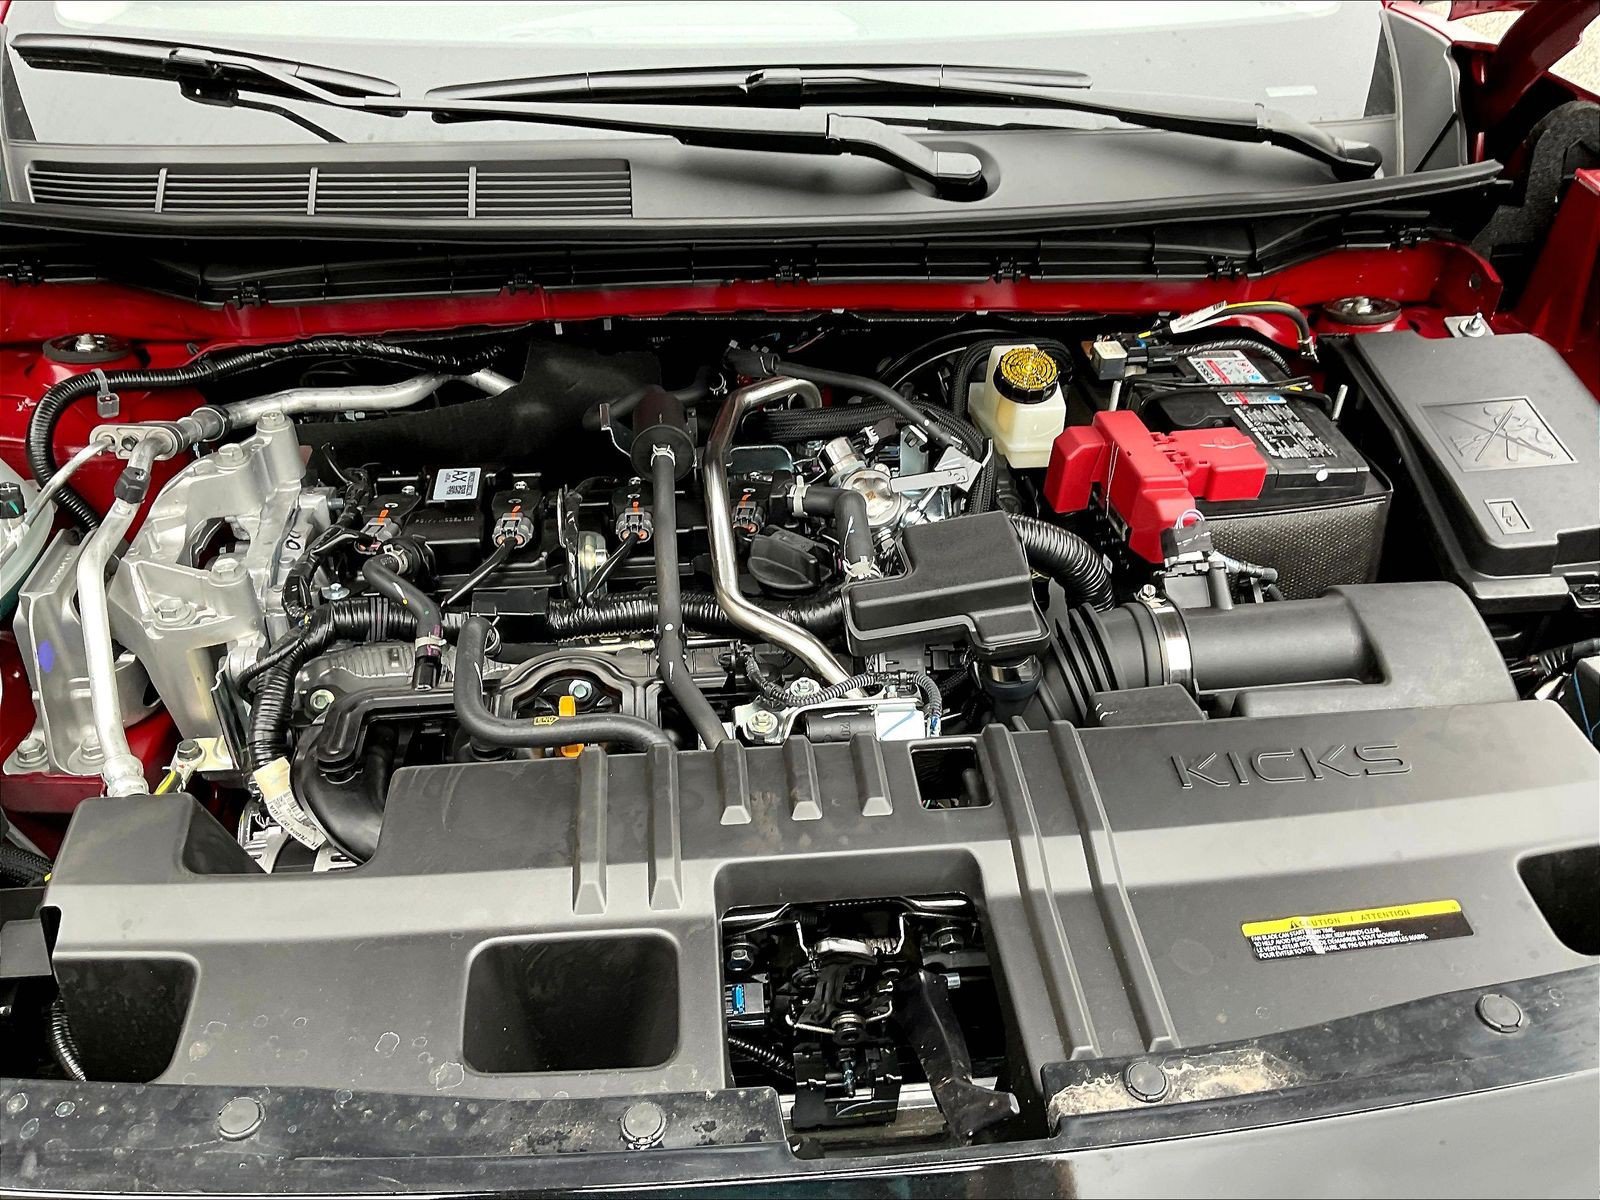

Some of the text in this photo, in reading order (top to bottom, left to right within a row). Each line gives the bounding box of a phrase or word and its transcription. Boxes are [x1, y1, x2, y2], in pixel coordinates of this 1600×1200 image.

[451, 470, 468, 484] AX
[1171, 741, 1412, 789] KICKS
[1361, 909, 1411, 921] ATTENTION
